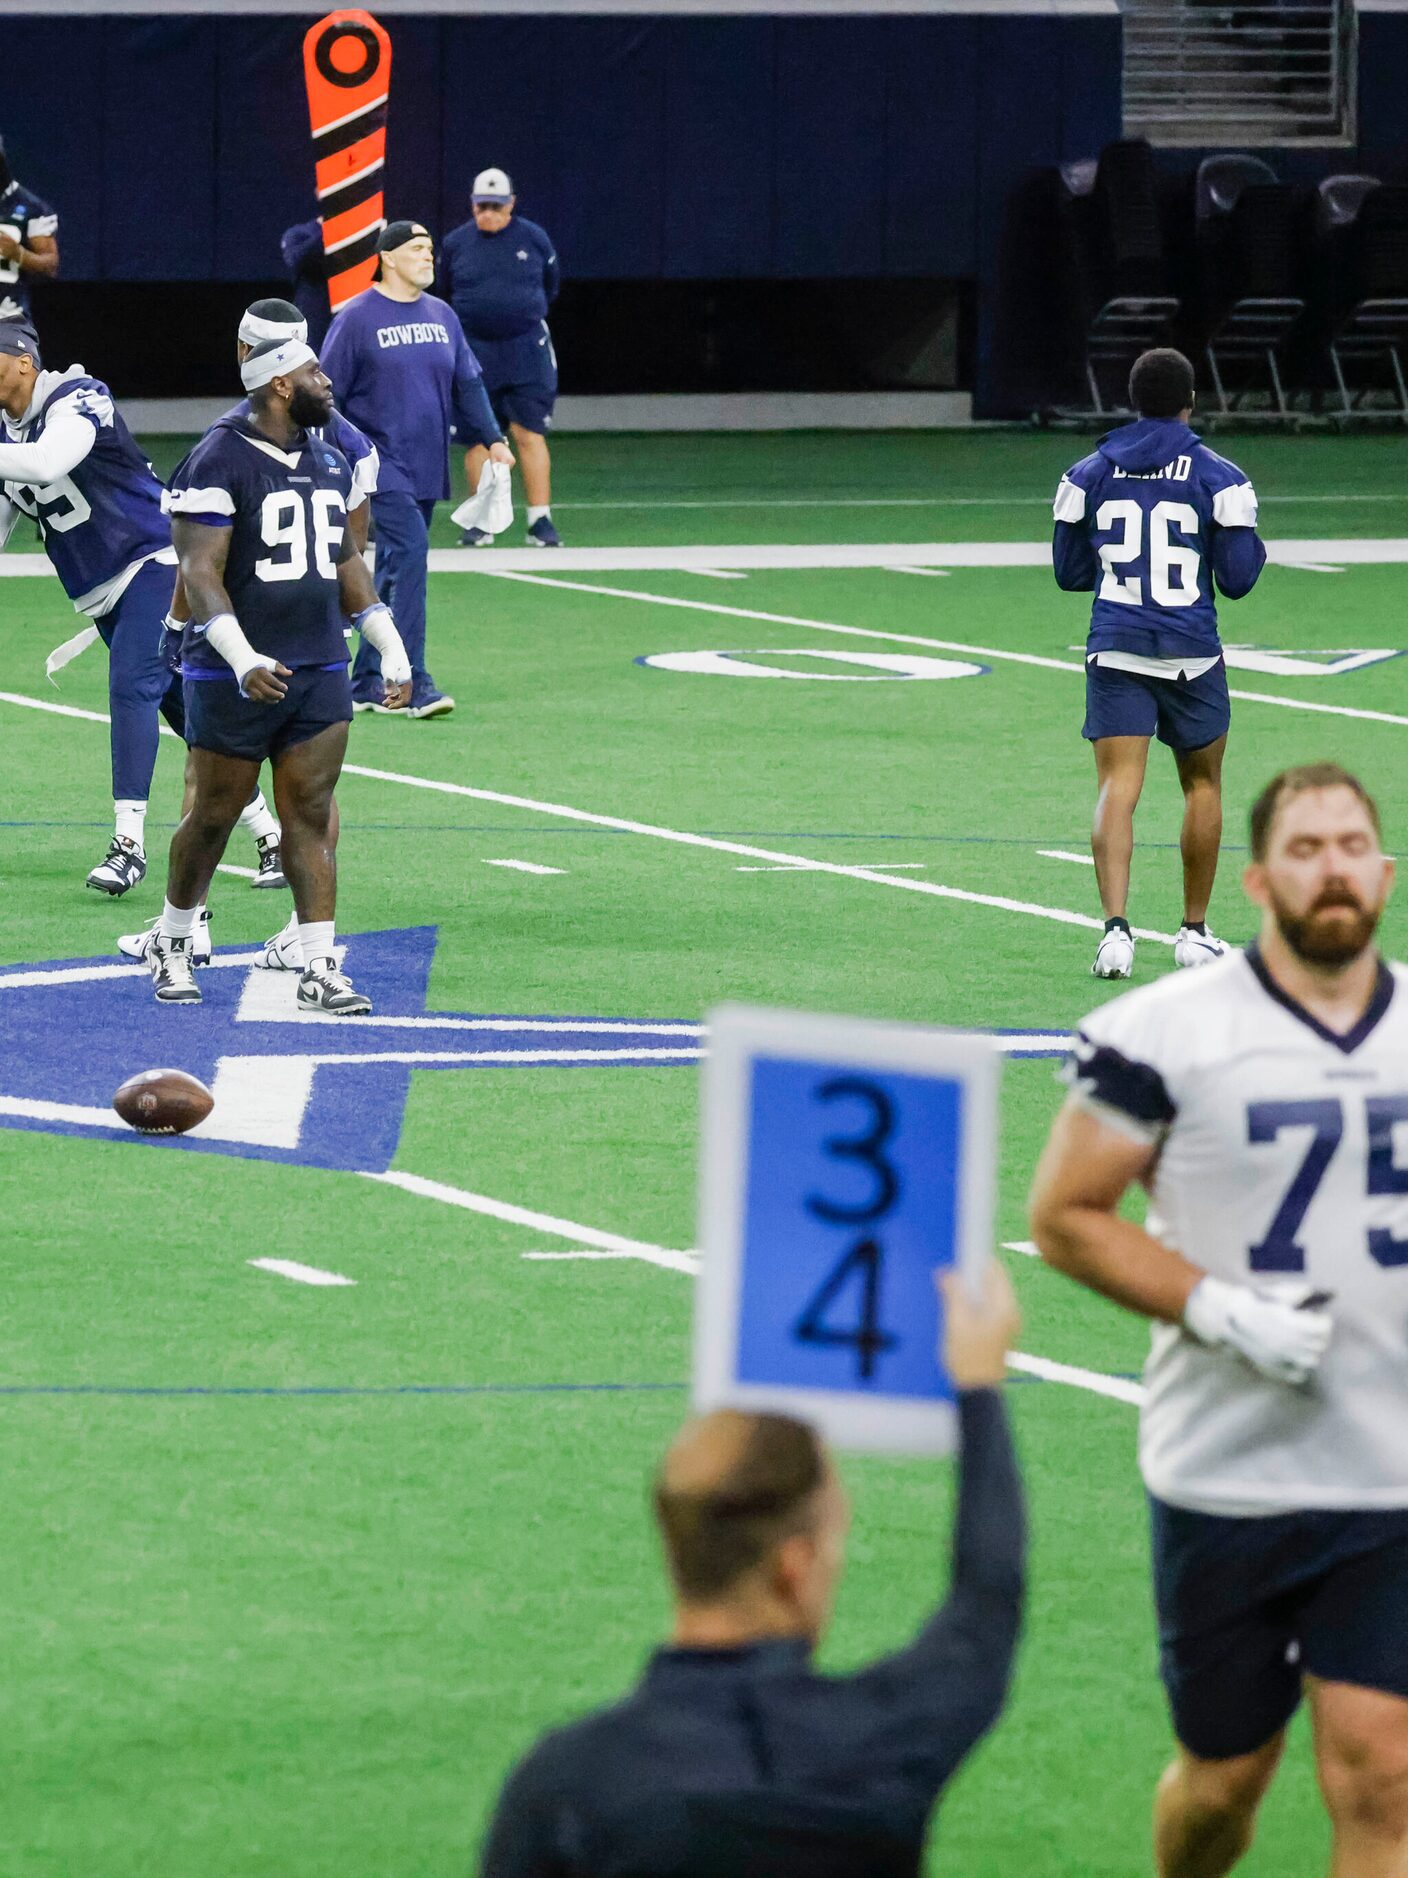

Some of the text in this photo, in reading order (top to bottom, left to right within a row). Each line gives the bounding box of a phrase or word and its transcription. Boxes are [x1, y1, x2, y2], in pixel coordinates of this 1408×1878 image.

[376, 323, 449, 349] COWBOYS
[255, 489, 347, 582] 96
[1096, 499, 1201, 607] 26
